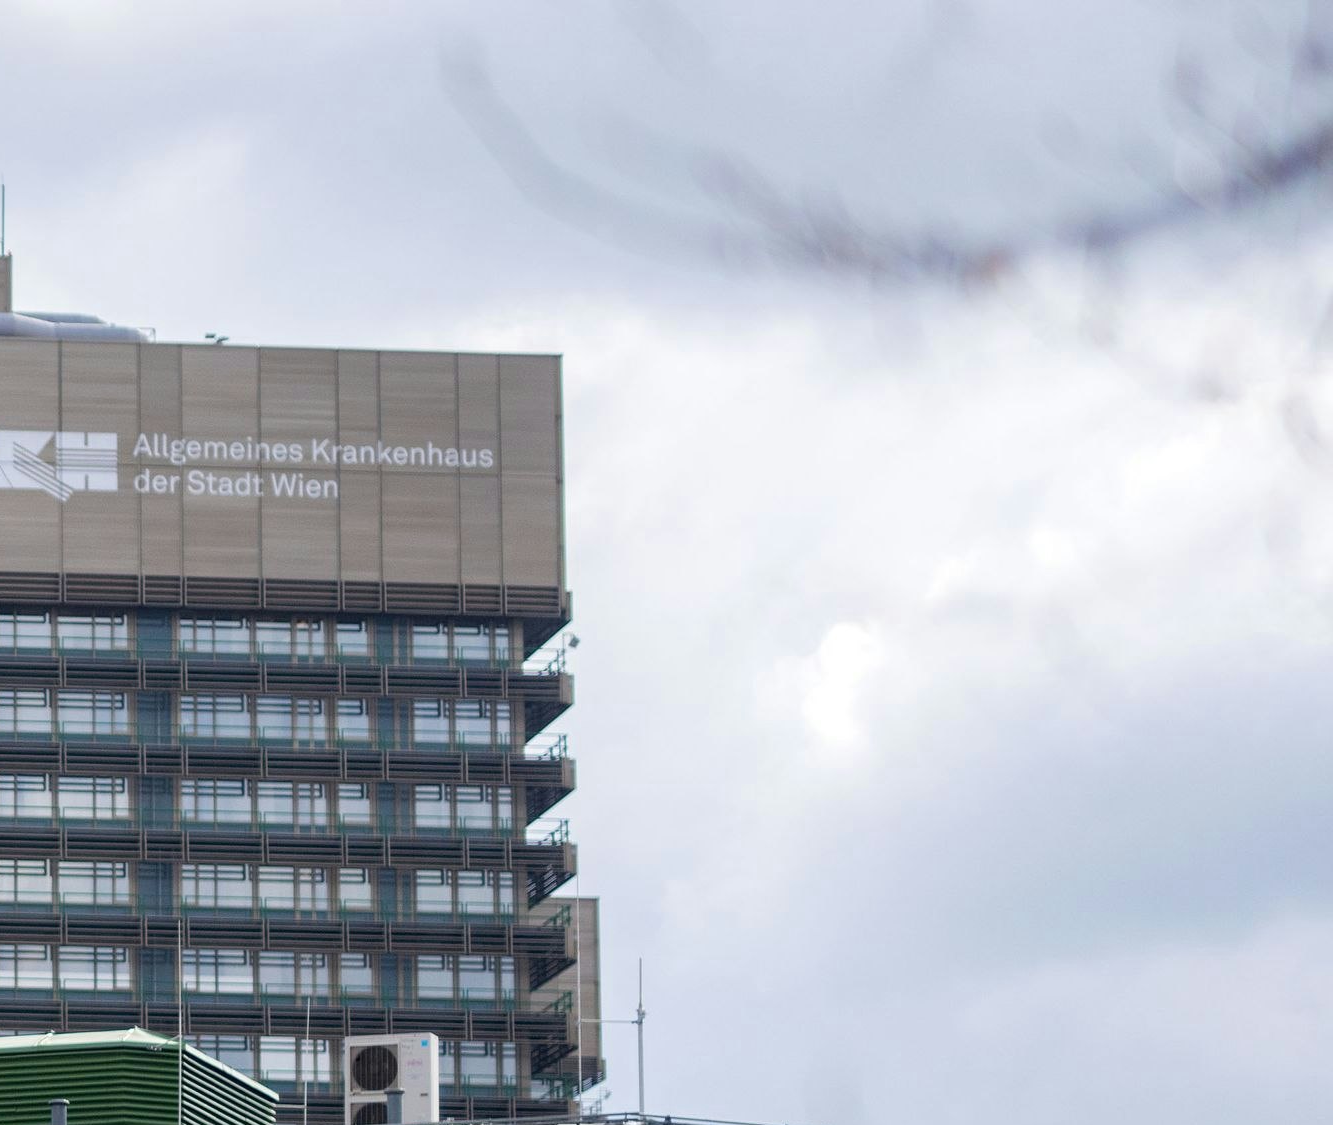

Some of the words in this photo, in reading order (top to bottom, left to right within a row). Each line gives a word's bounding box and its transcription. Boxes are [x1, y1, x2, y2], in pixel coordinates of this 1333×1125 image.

[133, 433, 304, 466] Allgemeines
[311, 438, 494, 468] Krankenhaus
[133, 470, 182, 494] der
[187, 471, 265, 496] Stadt
[271, 473, 339, 498] Wien
